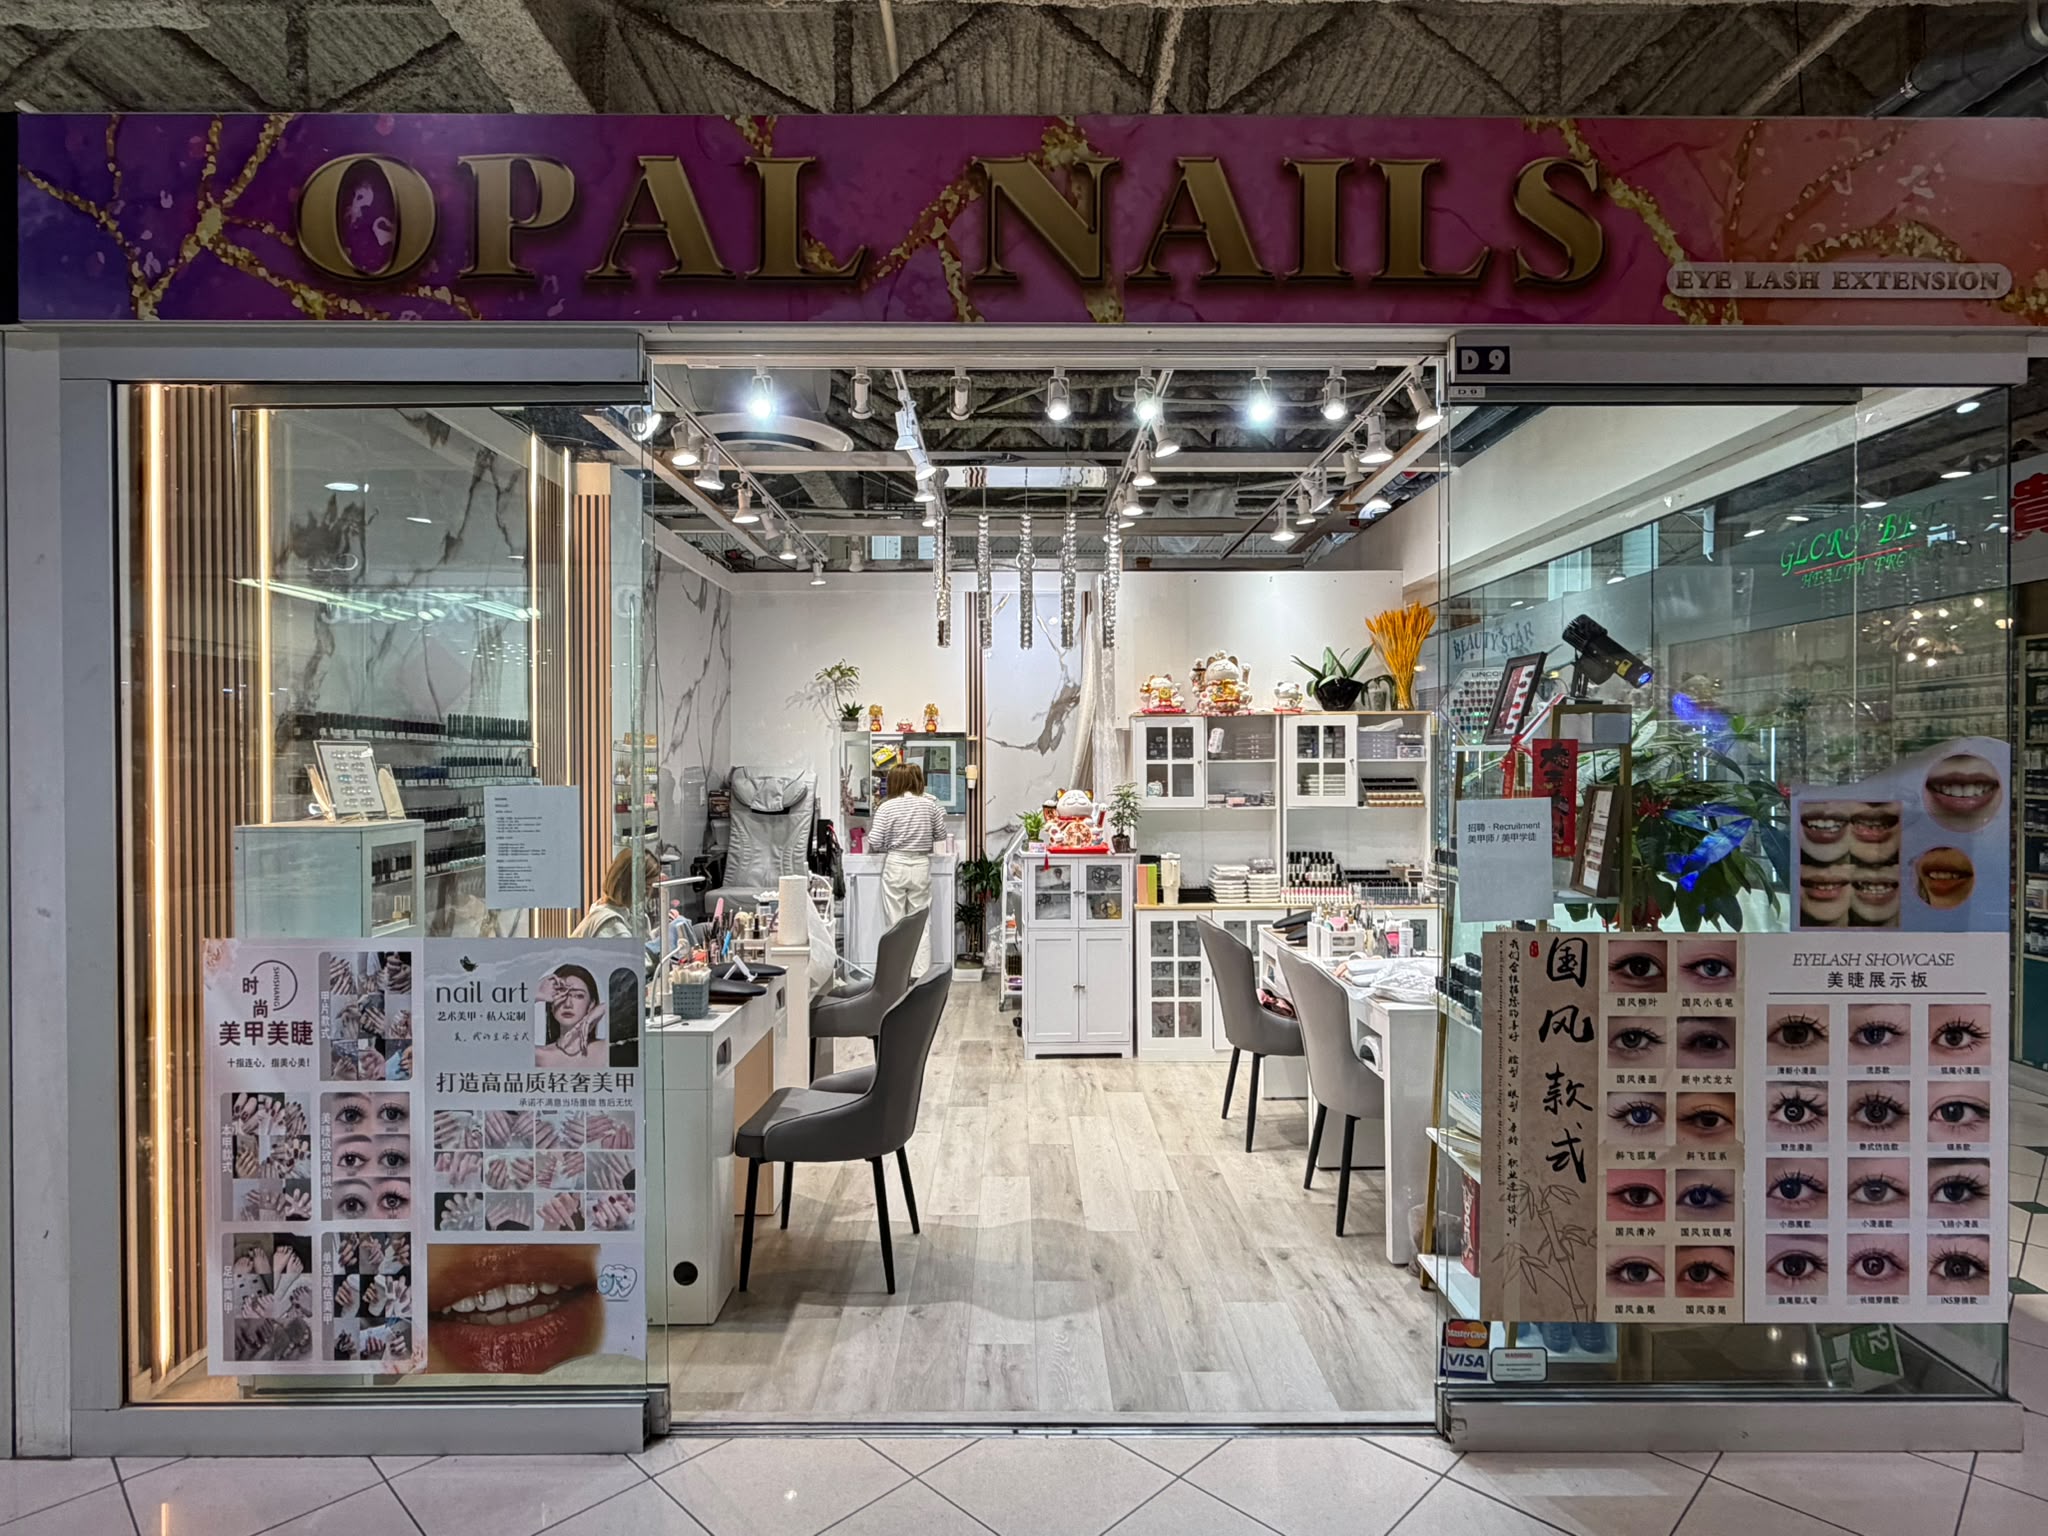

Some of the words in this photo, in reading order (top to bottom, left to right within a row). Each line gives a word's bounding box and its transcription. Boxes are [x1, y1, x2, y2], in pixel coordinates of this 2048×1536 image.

[298, 153, 868, 281] OPAL
[971, 155, 1604, 286] NAILS
[1677, 271, 1732, 289] EYE
[1745, 271, 1821, 290] LASH
[1832, 270, 2000, 291] EXTENSION
[1453, 632, 1498, 660] BEAUTY
[1501, 621, 1534, 654] STAR
[1493, 822, 1541, 831] Recruitment
[1792, 953, 1861, 967] EYELASH
[1865, 953, 1955, 966] SHOWCASE
[272, 966, 281, 1008] SHISHANG
[1827, 971, 1929, 989] 美睫展示板
[436, 981, 483, 1003] nail
[491, 981, 529, 1003] art
[1617, 997, 1658, 1008] 国风柳叶
[1682, 997, 1734, 1008] 国风小毛笔
[219, 1020, 314, 1046] 美甲美睫
[1538, 936, 1595, 1184] 国风款式
[436, 1072, 635, 1093] 打造高品质轻奢美甲
[1449, 1353, 1485, 1368] VISA
